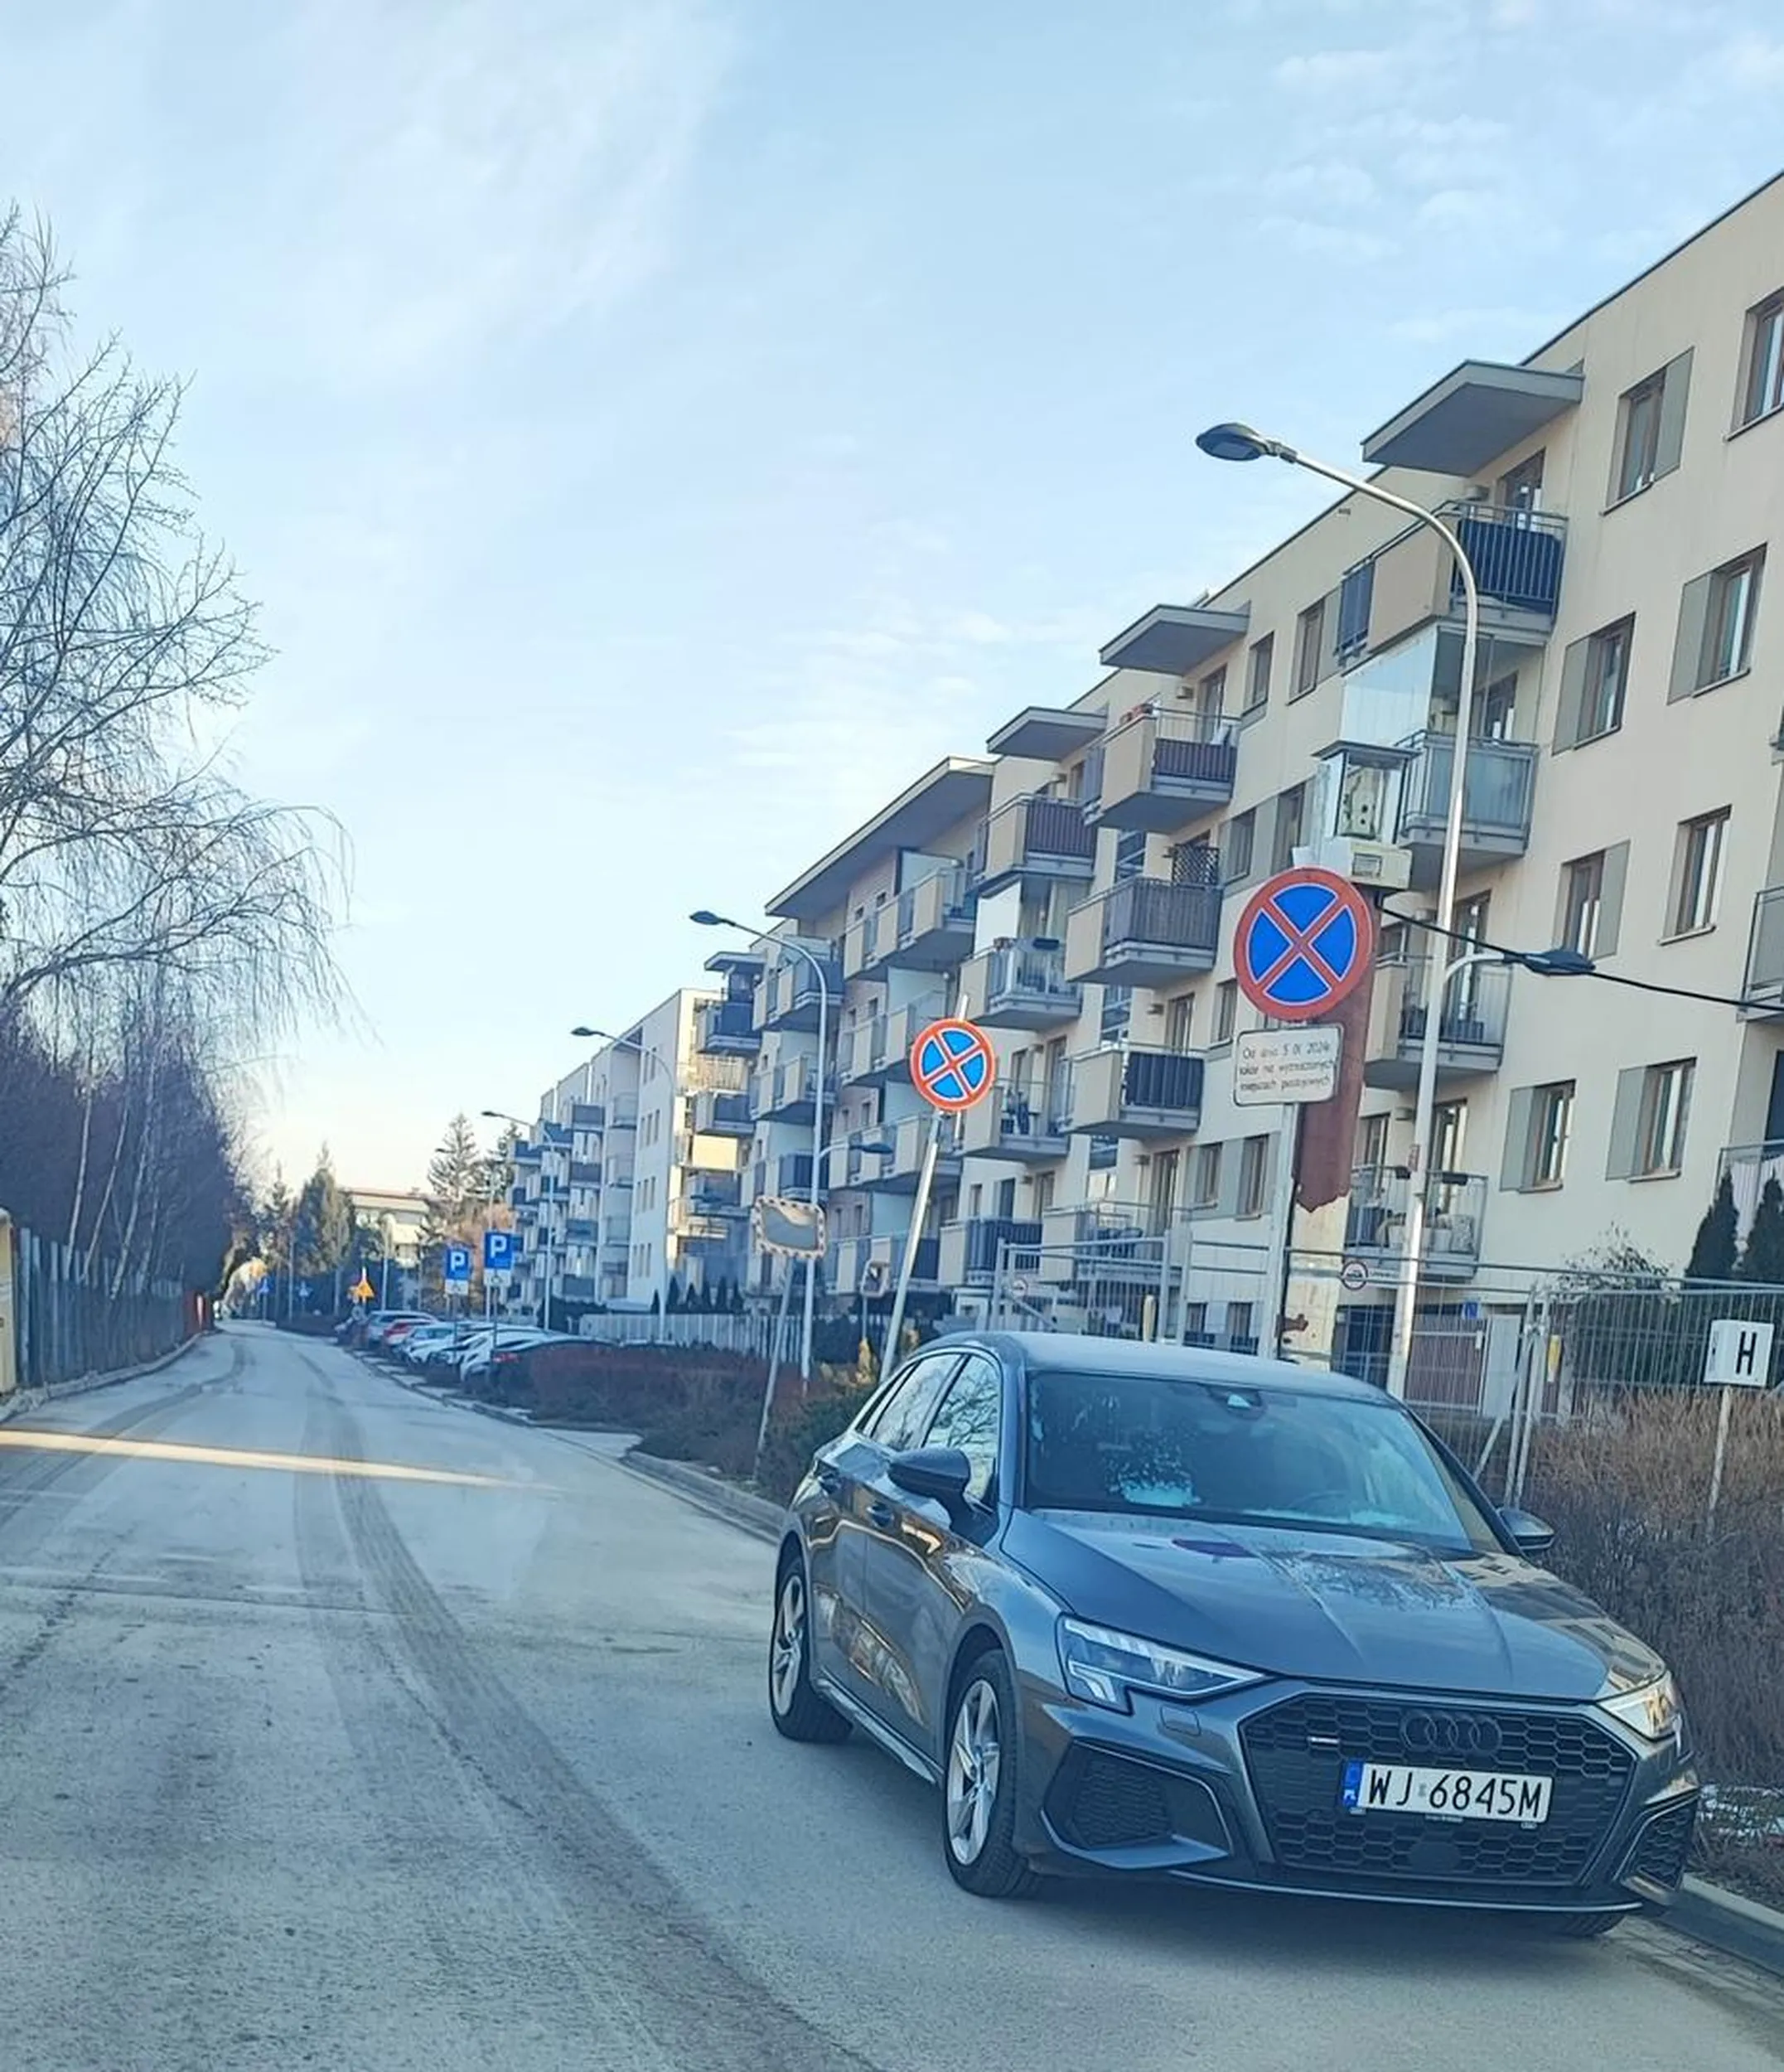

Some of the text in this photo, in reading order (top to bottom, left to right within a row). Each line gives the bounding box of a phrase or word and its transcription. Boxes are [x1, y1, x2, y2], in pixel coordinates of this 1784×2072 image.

[450, 1251, 466, 1271] P
[490, 1235, 507, 1258] P
[1736, 1330, 1757, 1376] H
[1368, 1769, 1543, 1818] WJ 6845M
